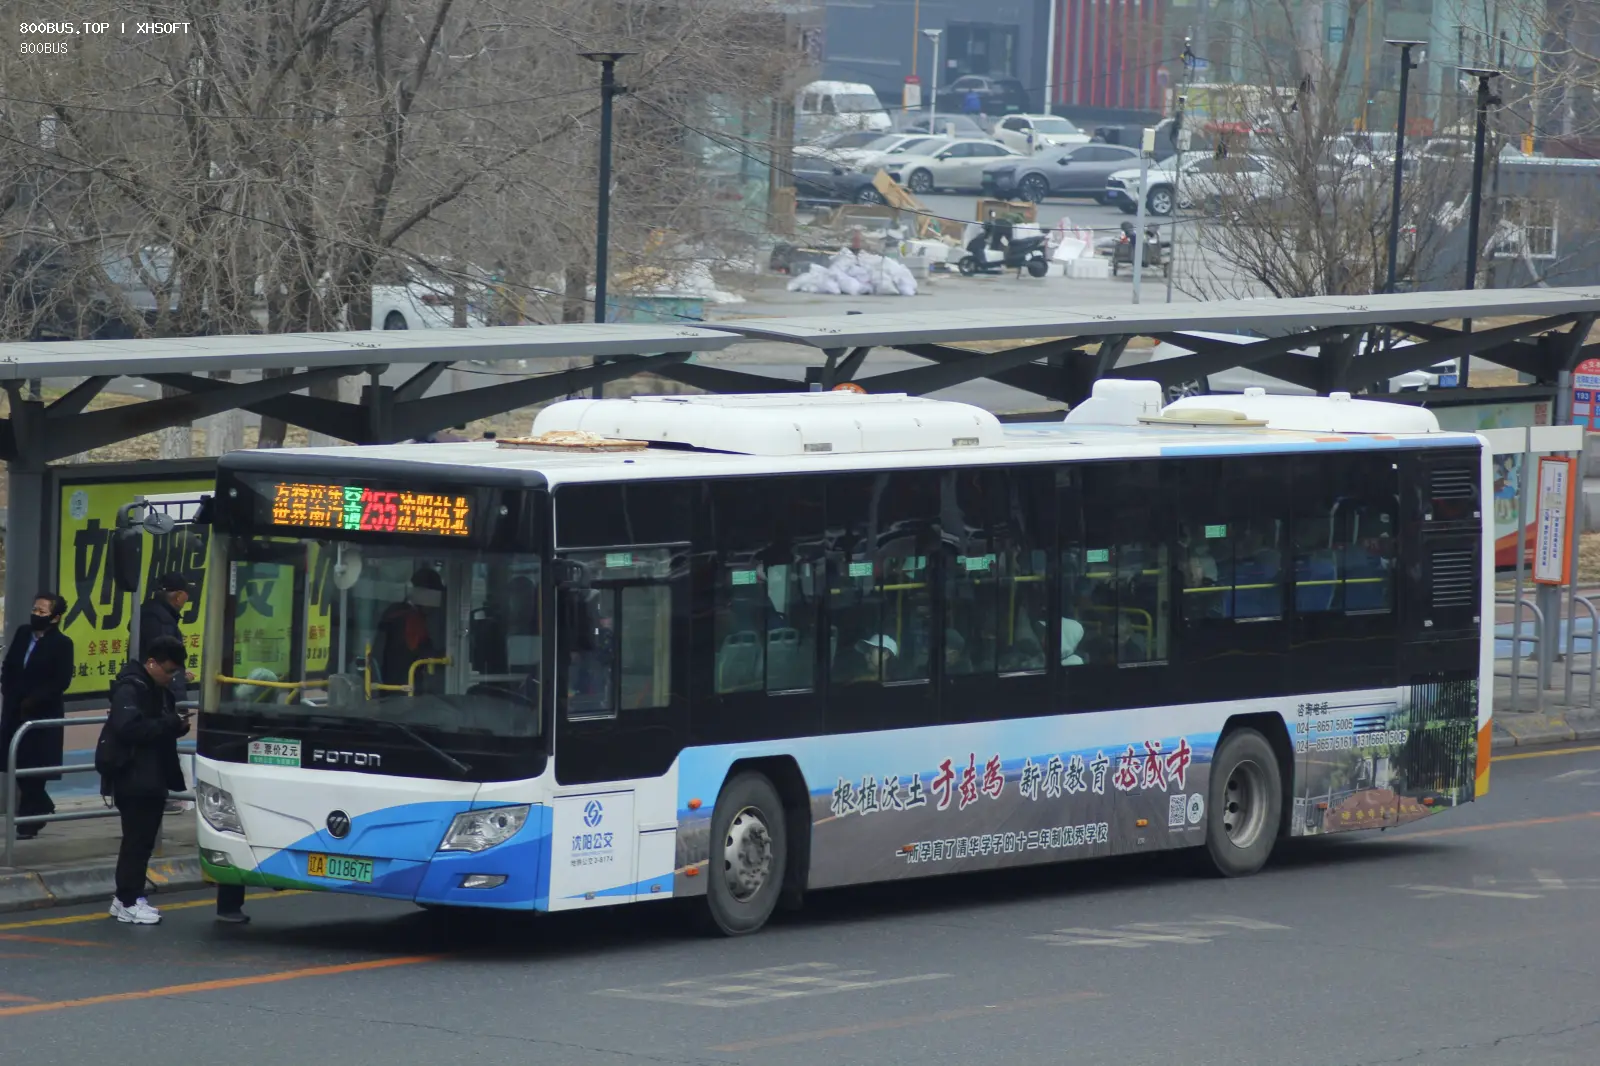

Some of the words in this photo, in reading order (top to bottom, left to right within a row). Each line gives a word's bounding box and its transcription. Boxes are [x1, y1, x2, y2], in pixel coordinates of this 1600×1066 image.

[360, 487, 399, 532] 255
[264, 743, 298, 757] 票价2元
[313, 749, 381, 767] FOTON
[571, 832, 614, 851] 沈阳公交
